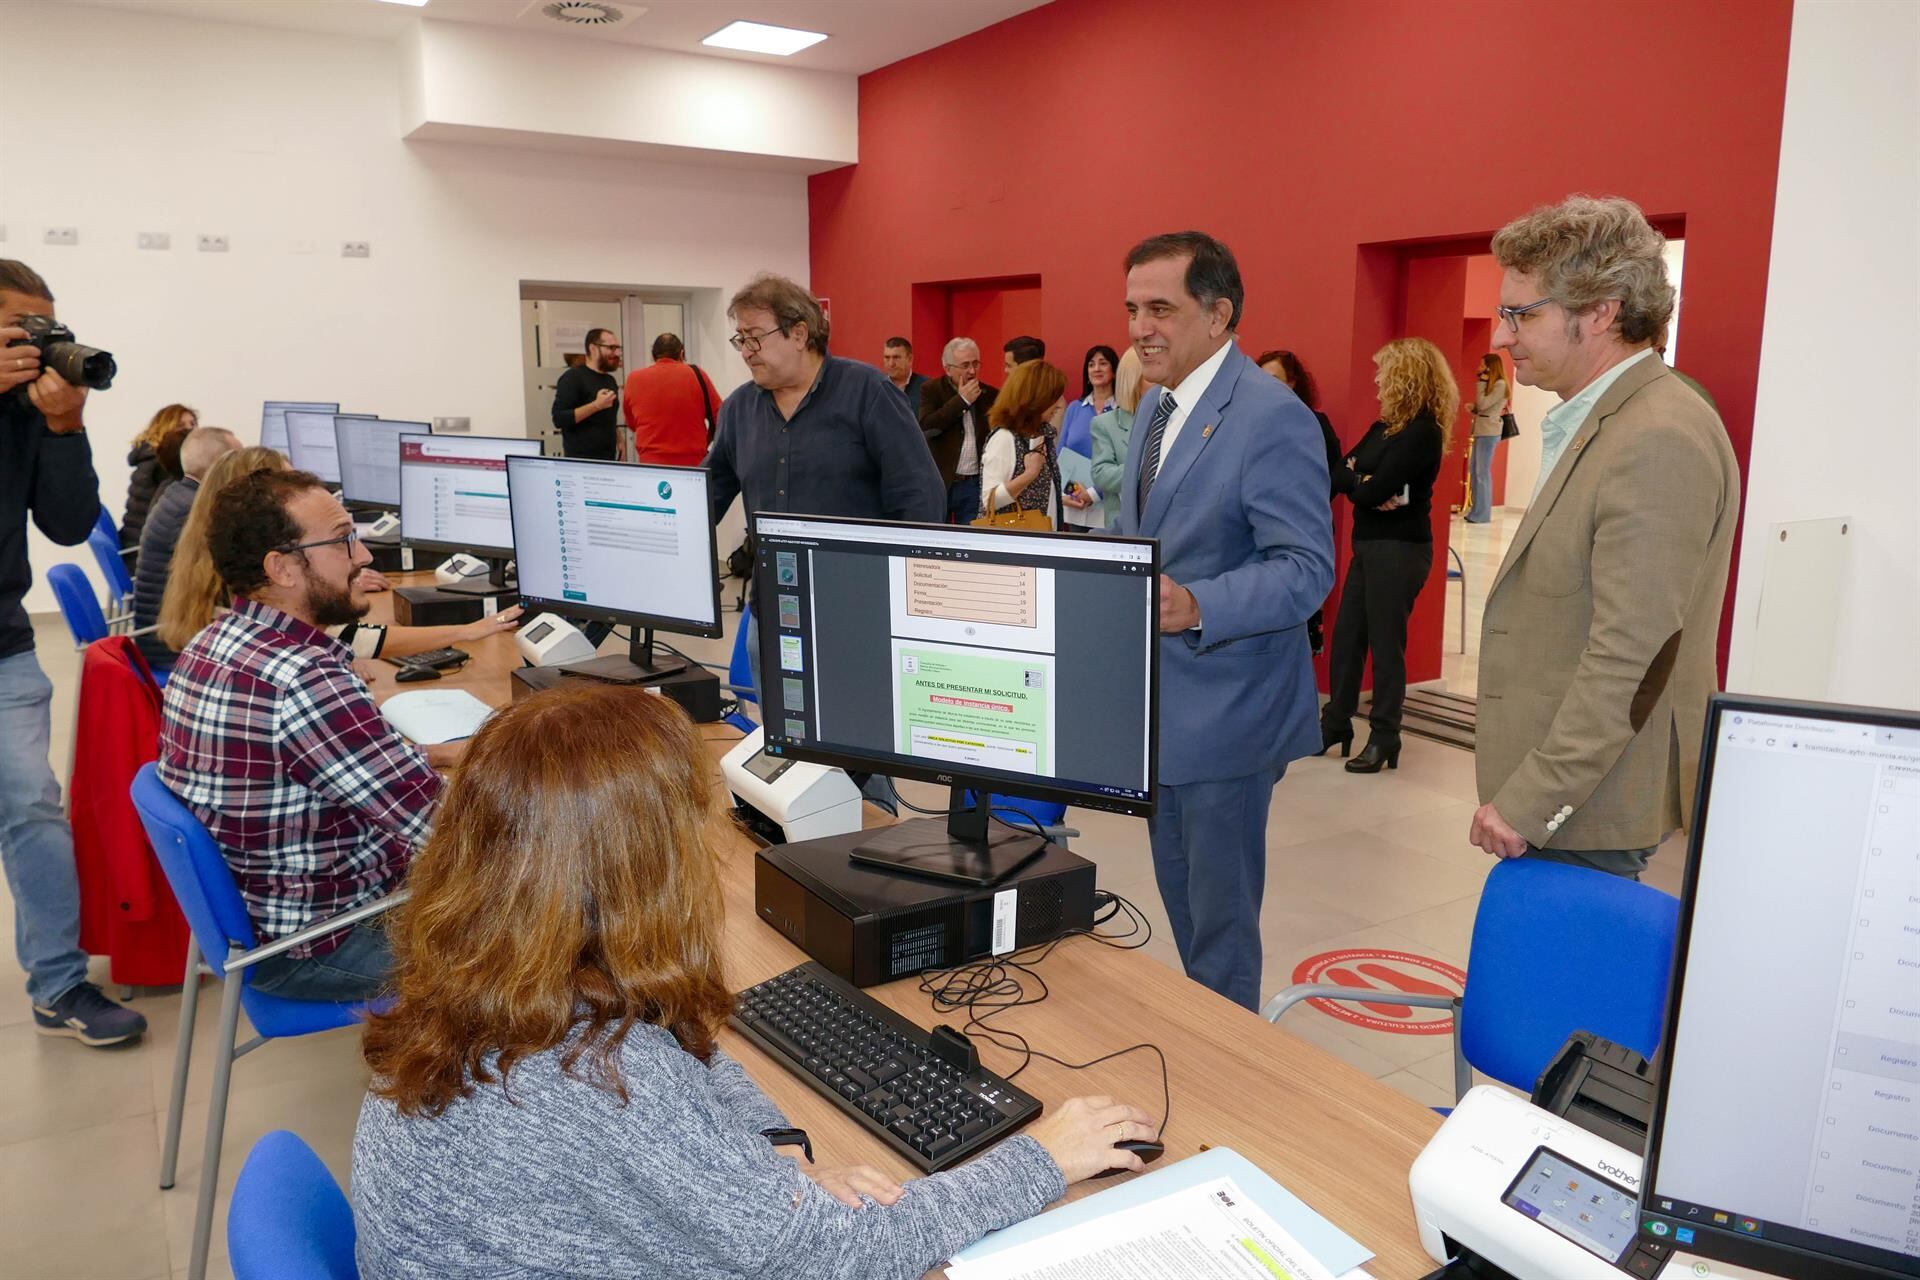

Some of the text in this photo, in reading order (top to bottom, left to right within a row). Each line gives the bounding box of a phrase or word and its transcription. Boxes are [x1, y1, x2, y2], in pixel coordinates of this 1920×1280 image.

[914, 598, 943, 606] Presentación
[915, 680, 936, 688] ANTES
[946, 684, 983, 694] PRESENTAR
[932, 696, 953, 704] Modelo
[963, 700, 990, 710] instancia
[1747, 718, 1783, 729] Plataforma
[1794, 722, 1836, 734] Distribución
[936, 774, 953, 783] AOC
[1880, 1054, 1917, 1067] Registro
[1874, 1090, 1911, 1103] Registro
[1868, 1124, 1919, 1141] Documento
[1597, 1160, 1639, 1186] brother
[1862, 1159, 1912, 1176] Documento
[1856, 1193, 1906, 1210] Documento
[1850, 1228, 1900, 1244] Documento
[1264, 1238, 1287, 1257] OFICIAL
